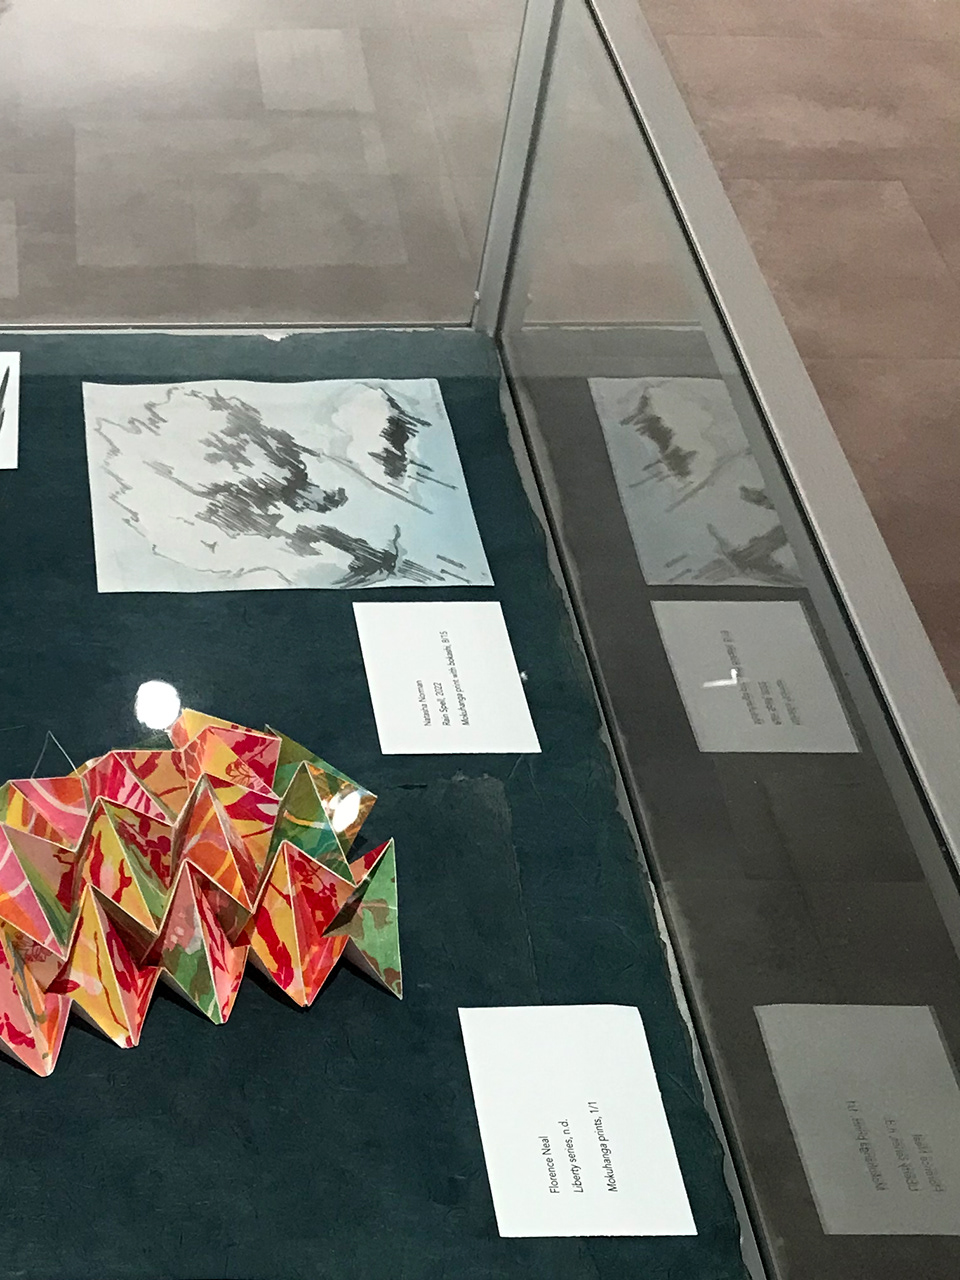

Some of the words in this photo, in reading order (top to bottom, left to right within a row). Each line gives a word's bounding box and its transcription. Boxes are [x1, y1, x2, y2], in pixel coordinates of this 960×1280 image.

[448, 667, 458, 678] with
[415, 680, 426, 703] Norman
[433, 682, 443, 696] 2022
[452, 679, 463, 692] print
[420, 703, 430, 727] Natasha
[441, 713, 450, 726] Rain
[455, 693, 469, 726] Mokuhanga
[587, 1101, 599, 1114] 1/1
[593, 1115, 607, 1142] prints,
[538, 1135, 551, 1155] Neal
[563, 1136, 577, 1163] series,
[545, 1157, 559, 1194] Florence
[568, 1164, 583, 1193] Liberty
[600, 1143, 617, 1193] Mokuhanga
